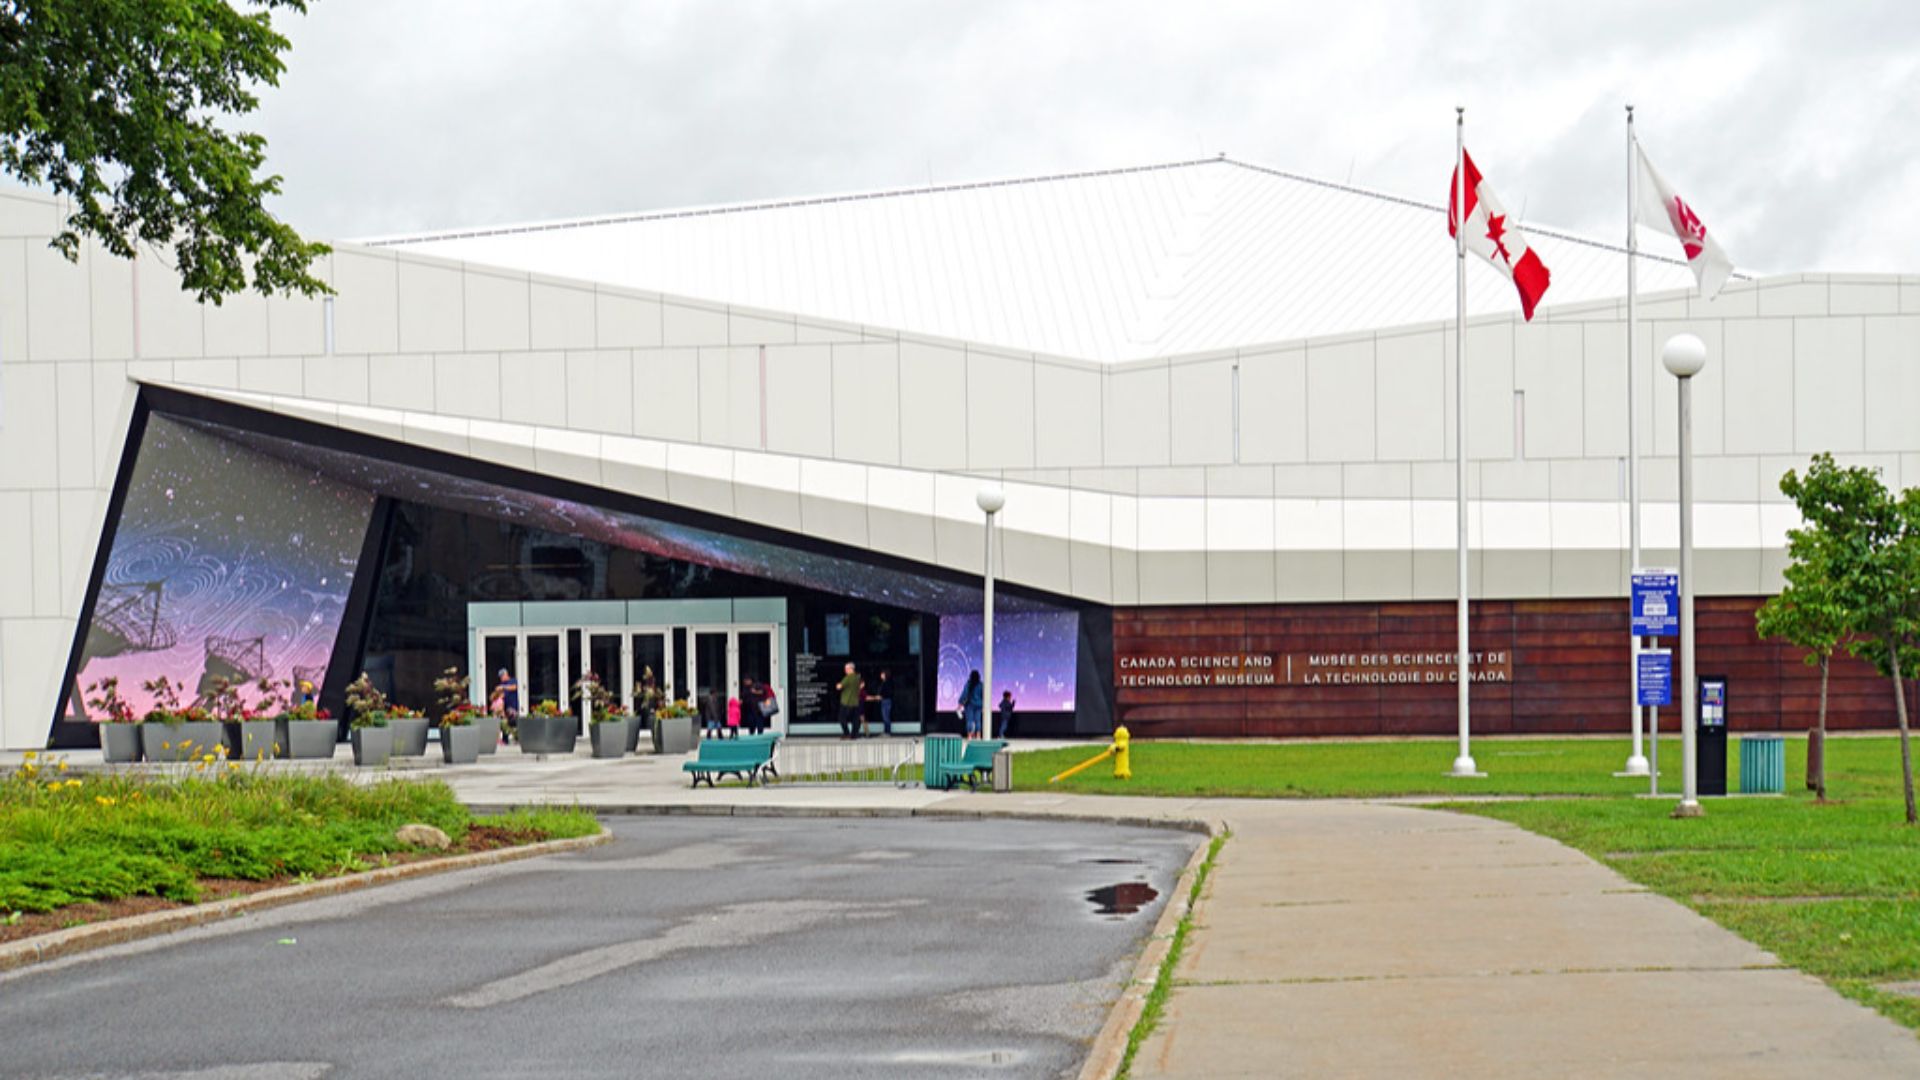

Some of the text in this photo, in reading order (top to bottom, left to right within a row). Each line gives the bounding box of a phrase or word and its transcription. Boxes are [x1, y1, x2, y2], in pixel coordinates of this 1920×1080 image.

[1120, 655, 1273, 668] CANADA SCIENCE AND
[1309, 652, 1356, 666] MUSÉE
[1360, 654, 1389, 666] DES
[1488, 651, 1505, 664] DE
[1121, 673, 1274, 686] TECHNOLOGY MUSEUM
[1304, 670, 1505, 684] LA TECHNOLOGIE DU CNADA
